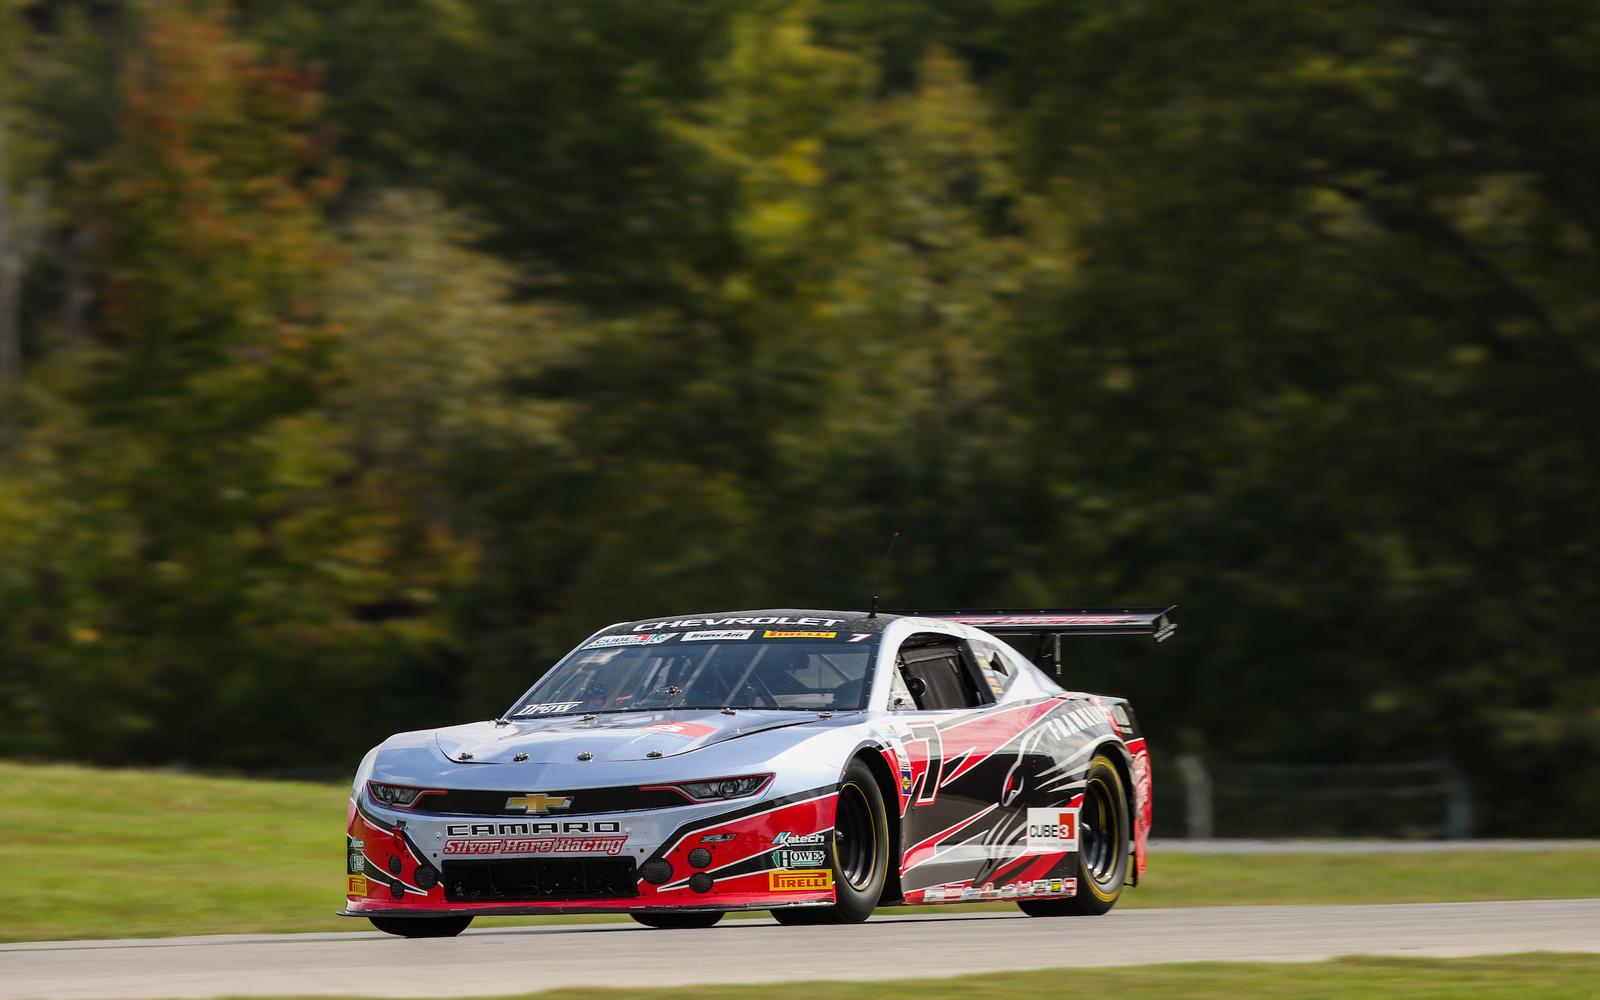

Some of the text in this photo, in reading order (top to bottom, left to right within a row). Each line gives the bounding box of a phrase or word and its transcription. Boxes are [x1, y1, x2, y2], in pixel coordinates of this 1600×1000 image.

[632, 617, 845, 631] CHEVROLET
[846, 633, 872, 642] 7
[907, 721, 944, 806] 7
[445, 821, 621, 837] CAMARO
[1029, 824, 1070, 838] CUBE3
[443, 836, 628, 855] Silver Hare Racing
[772, 832, 825, 846] Katech
[778, 850, 824, 868] HOWE
[773, 872, 828, 888] PIRELLI
